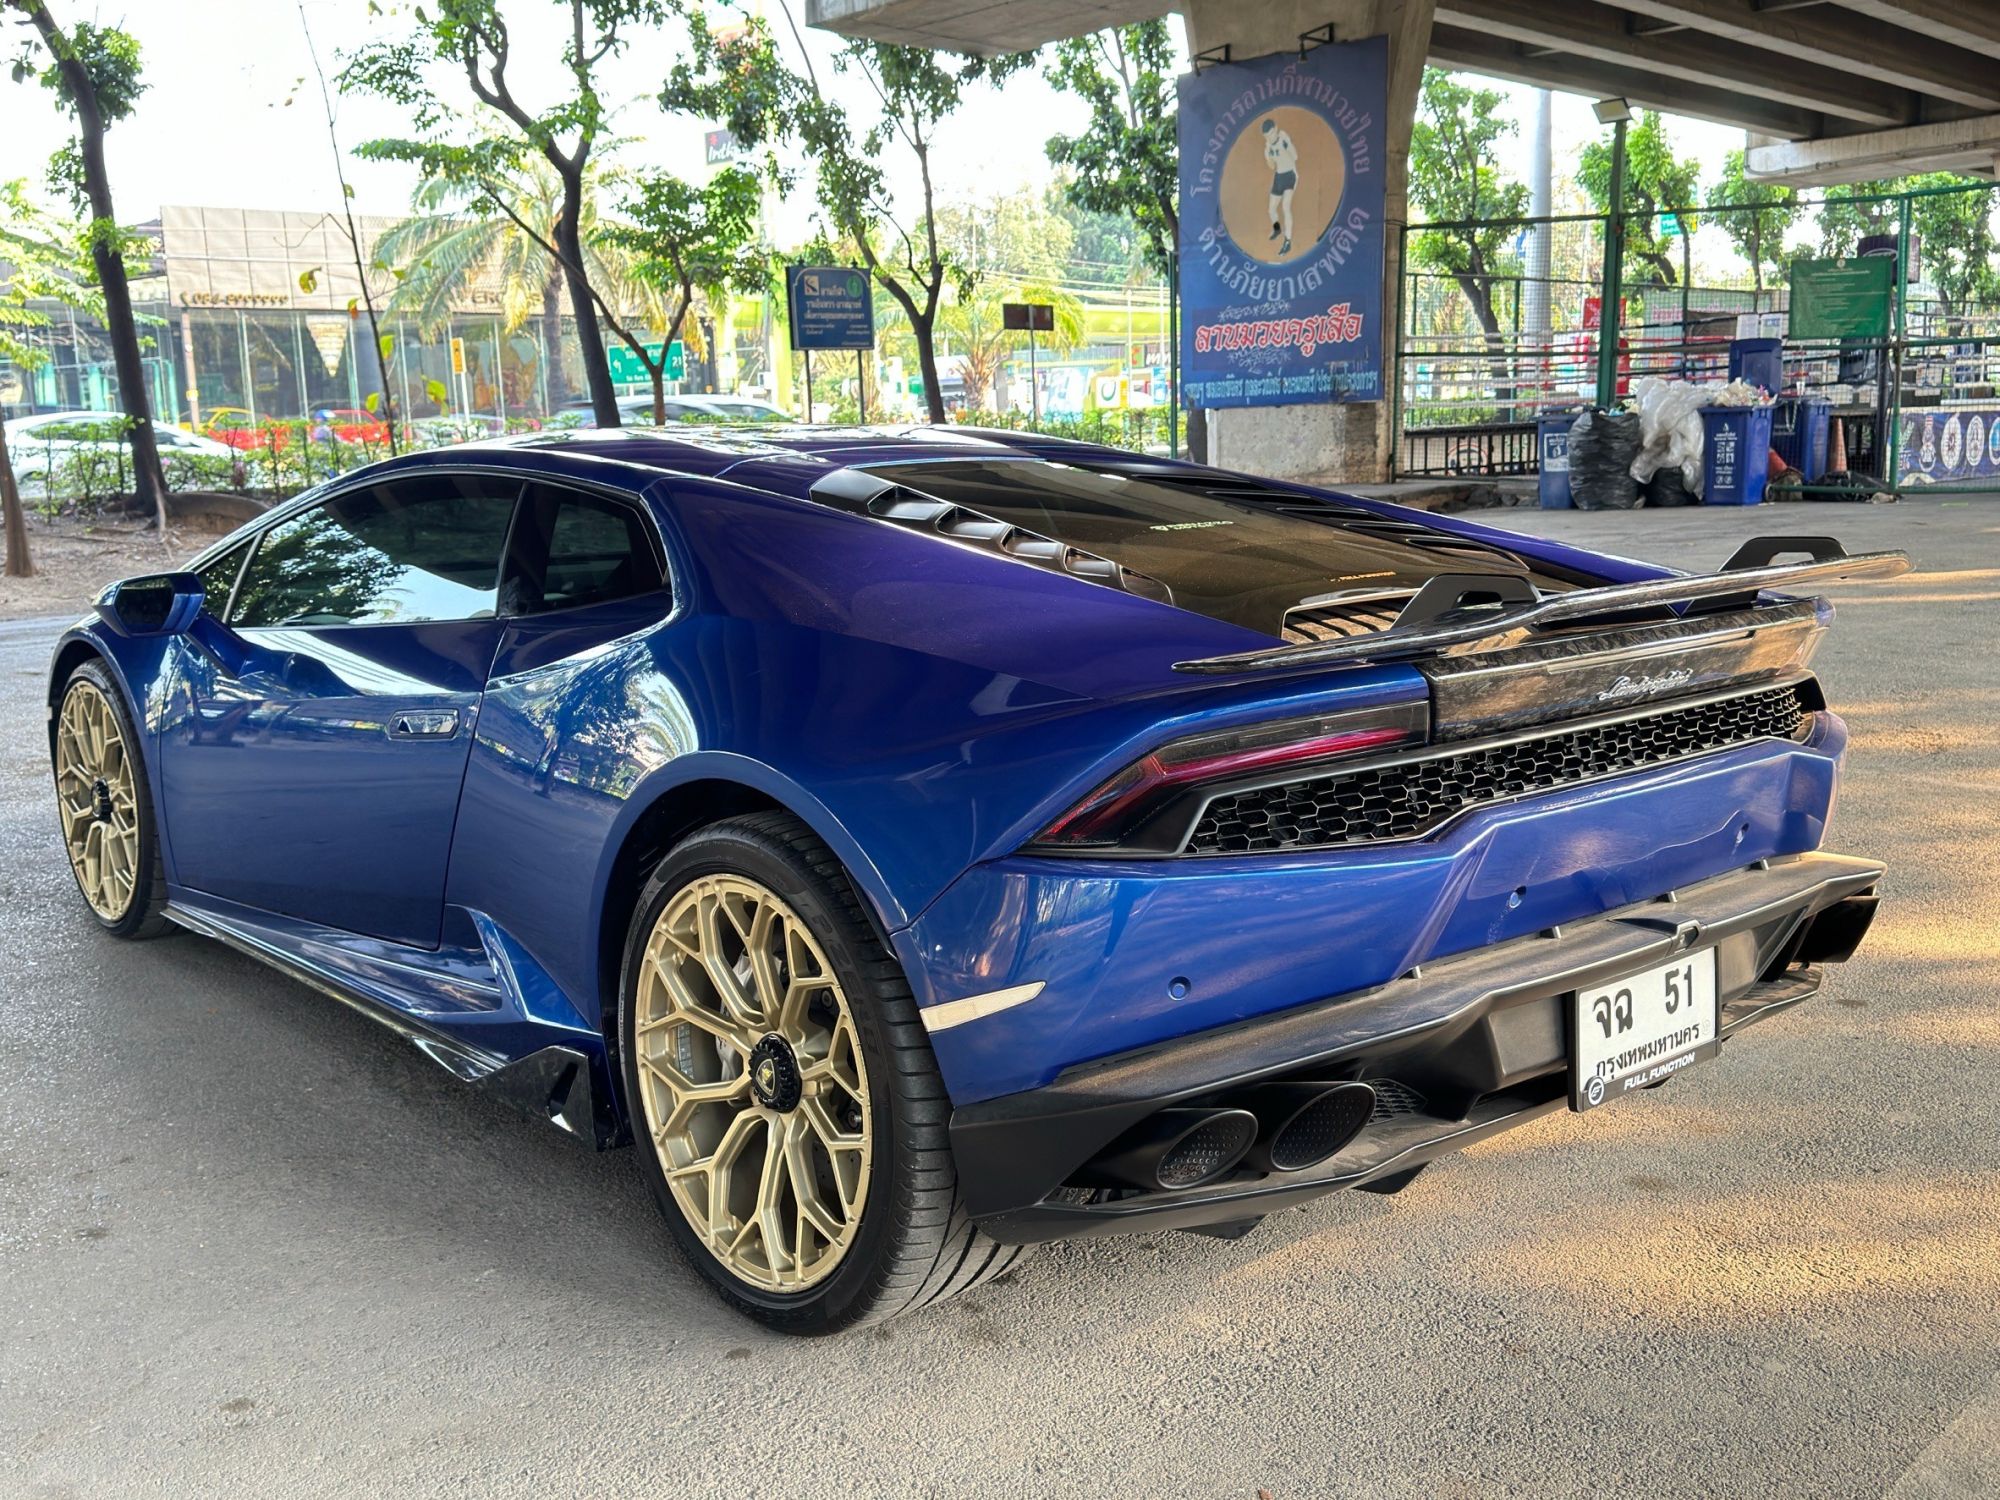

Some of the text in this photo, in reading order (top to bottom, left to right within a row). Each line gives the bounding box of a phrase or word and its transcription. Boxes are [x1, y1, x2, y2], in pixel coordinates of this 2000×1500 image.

[1190, 63, 1372, 197] โครงการลานกีฬามวยไทย
[1198, 207, 1370, 301] ต้านภัยยาเสพติด
[1195, 303, 1364, 357] ลานมวยครูเสือ
[672, 355, 682, 367] 21
[1664, 965, 1693, 1015] 51
[1596, 1023, 1701, 1080] กรุงเทพมหานคร
[1623, 1052, 1696, 1091] FULL FUNCTION
